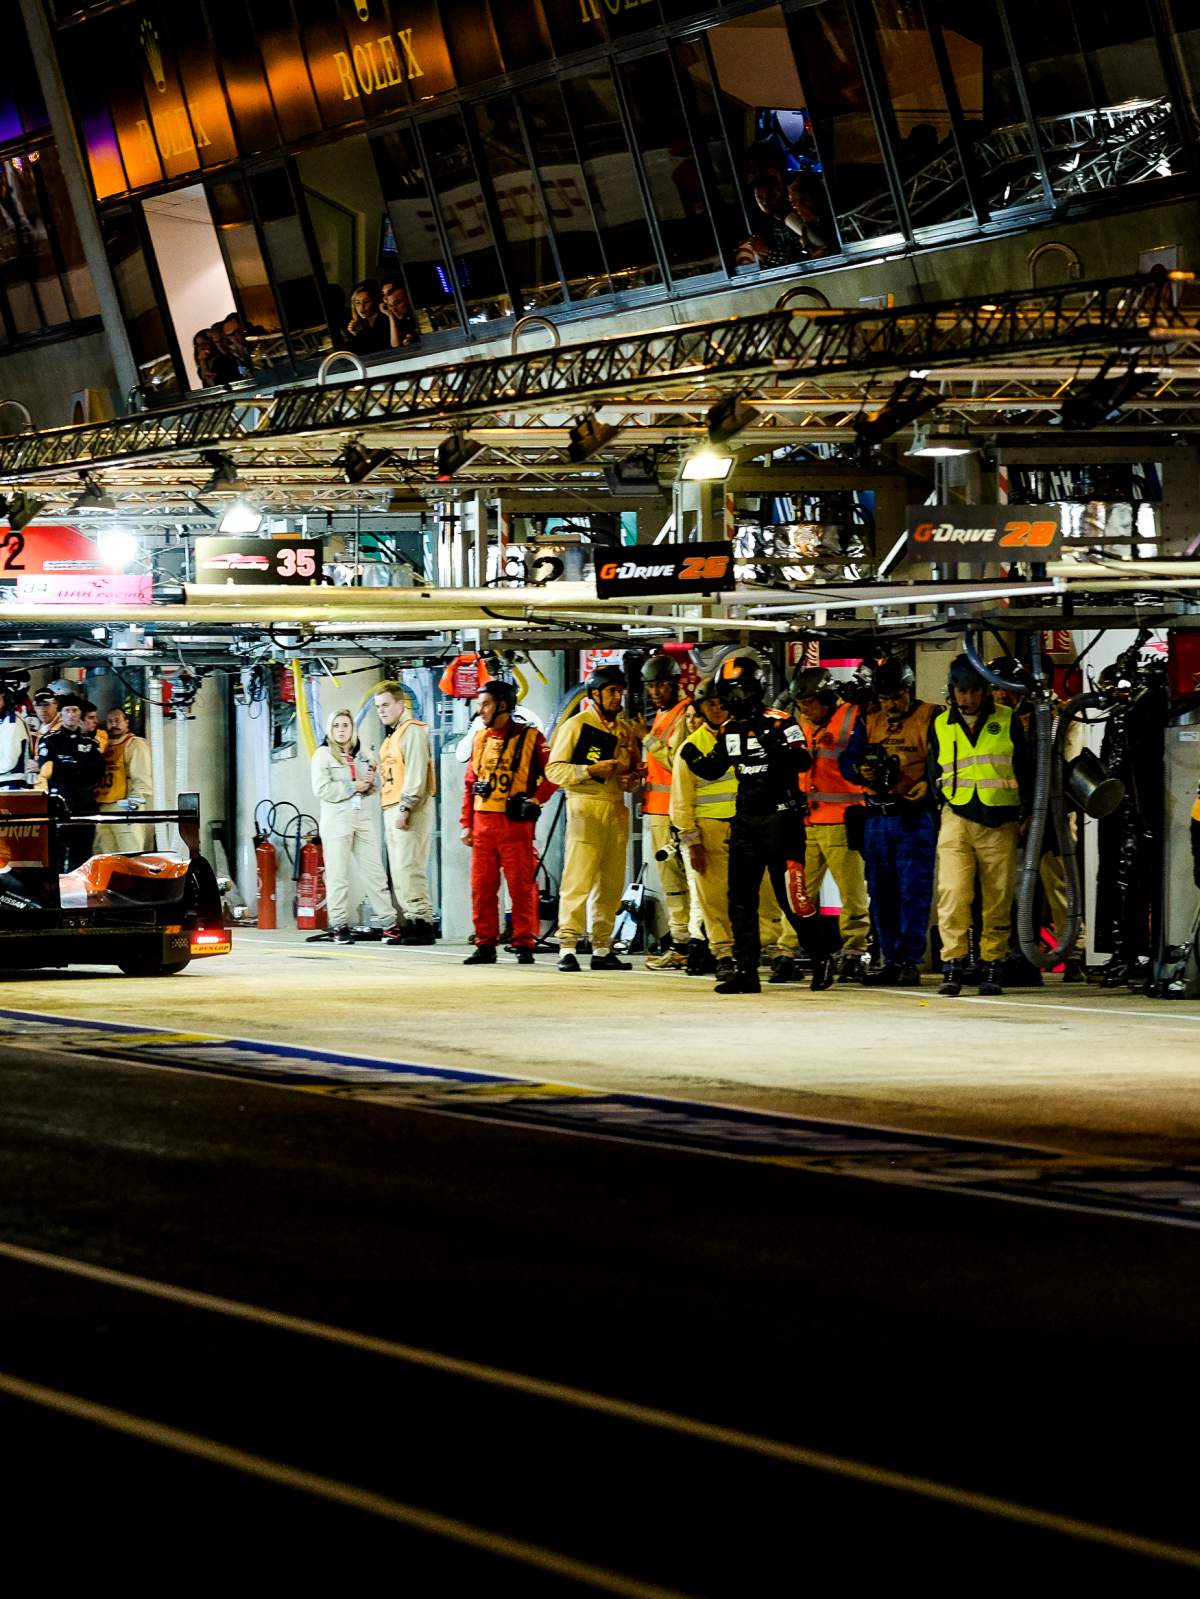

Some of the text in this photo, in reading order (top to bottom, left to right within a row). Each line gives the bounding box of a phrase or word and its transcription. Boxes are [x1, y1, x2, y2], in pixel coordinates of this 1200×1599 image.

[333, 28, 425, 100] ROLEX
[999, 521, 1057, 547] 28
[276, 548, 316, 577] 35
[678, 556, 730, 580] 26
